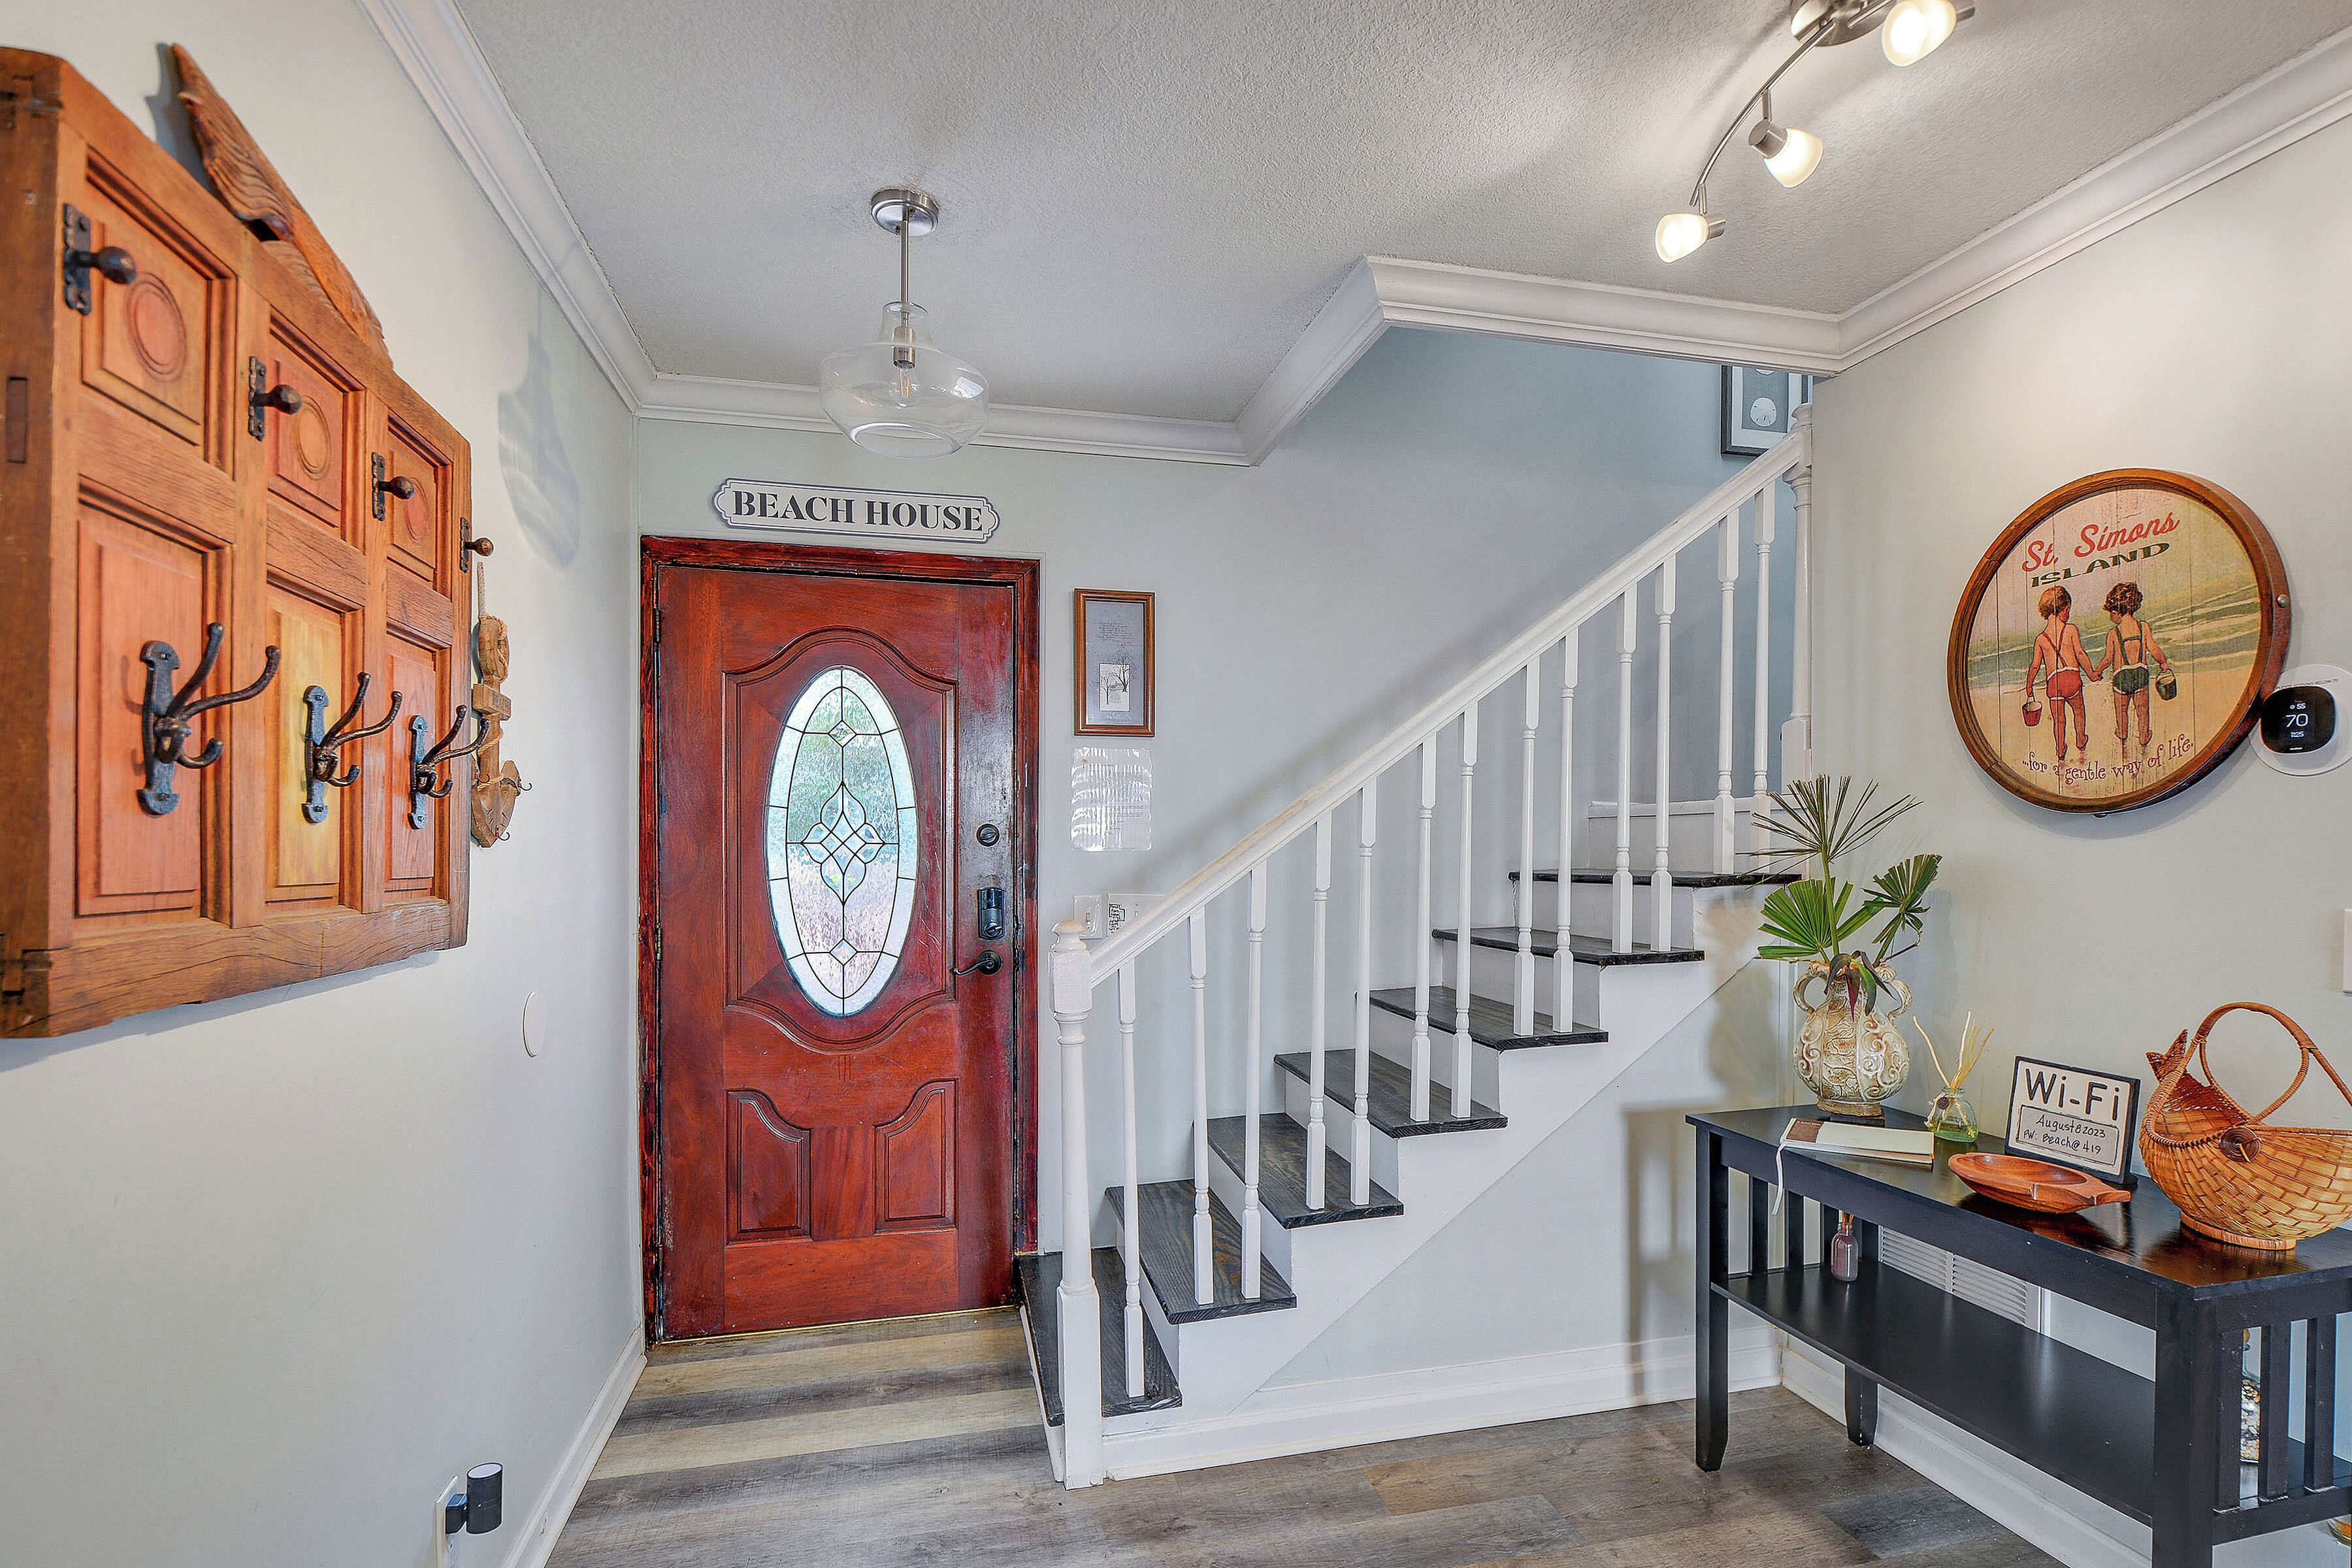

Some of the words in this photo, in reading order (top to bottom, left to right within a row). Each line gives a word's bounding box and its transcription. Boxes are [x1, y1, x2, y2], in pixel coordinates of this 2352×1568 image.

[732, 489, 856, 523] BEACH
[865, 500, 983, 531] HOUSE
[2022, 540, 2059, 572] St.
[2074, 512, 2180, 558] Simons
[2031, 543, 2170, 588] ISLAND
[2285, 713, 2308, 727] 70
[2052, 764, 2059, 776] a
[2065, 760, 2106, 785] gentle
[2111, 760, 2143, 779] way
[2148, 743, 2164, 768] of
[2168, 733, 2194, 760] life.
[2025, 1068, 2119, 1121] Wi-Fi
[2036, 1114, 2074, 1133] August
[2082, 1126, 2106, 1138] 2023
